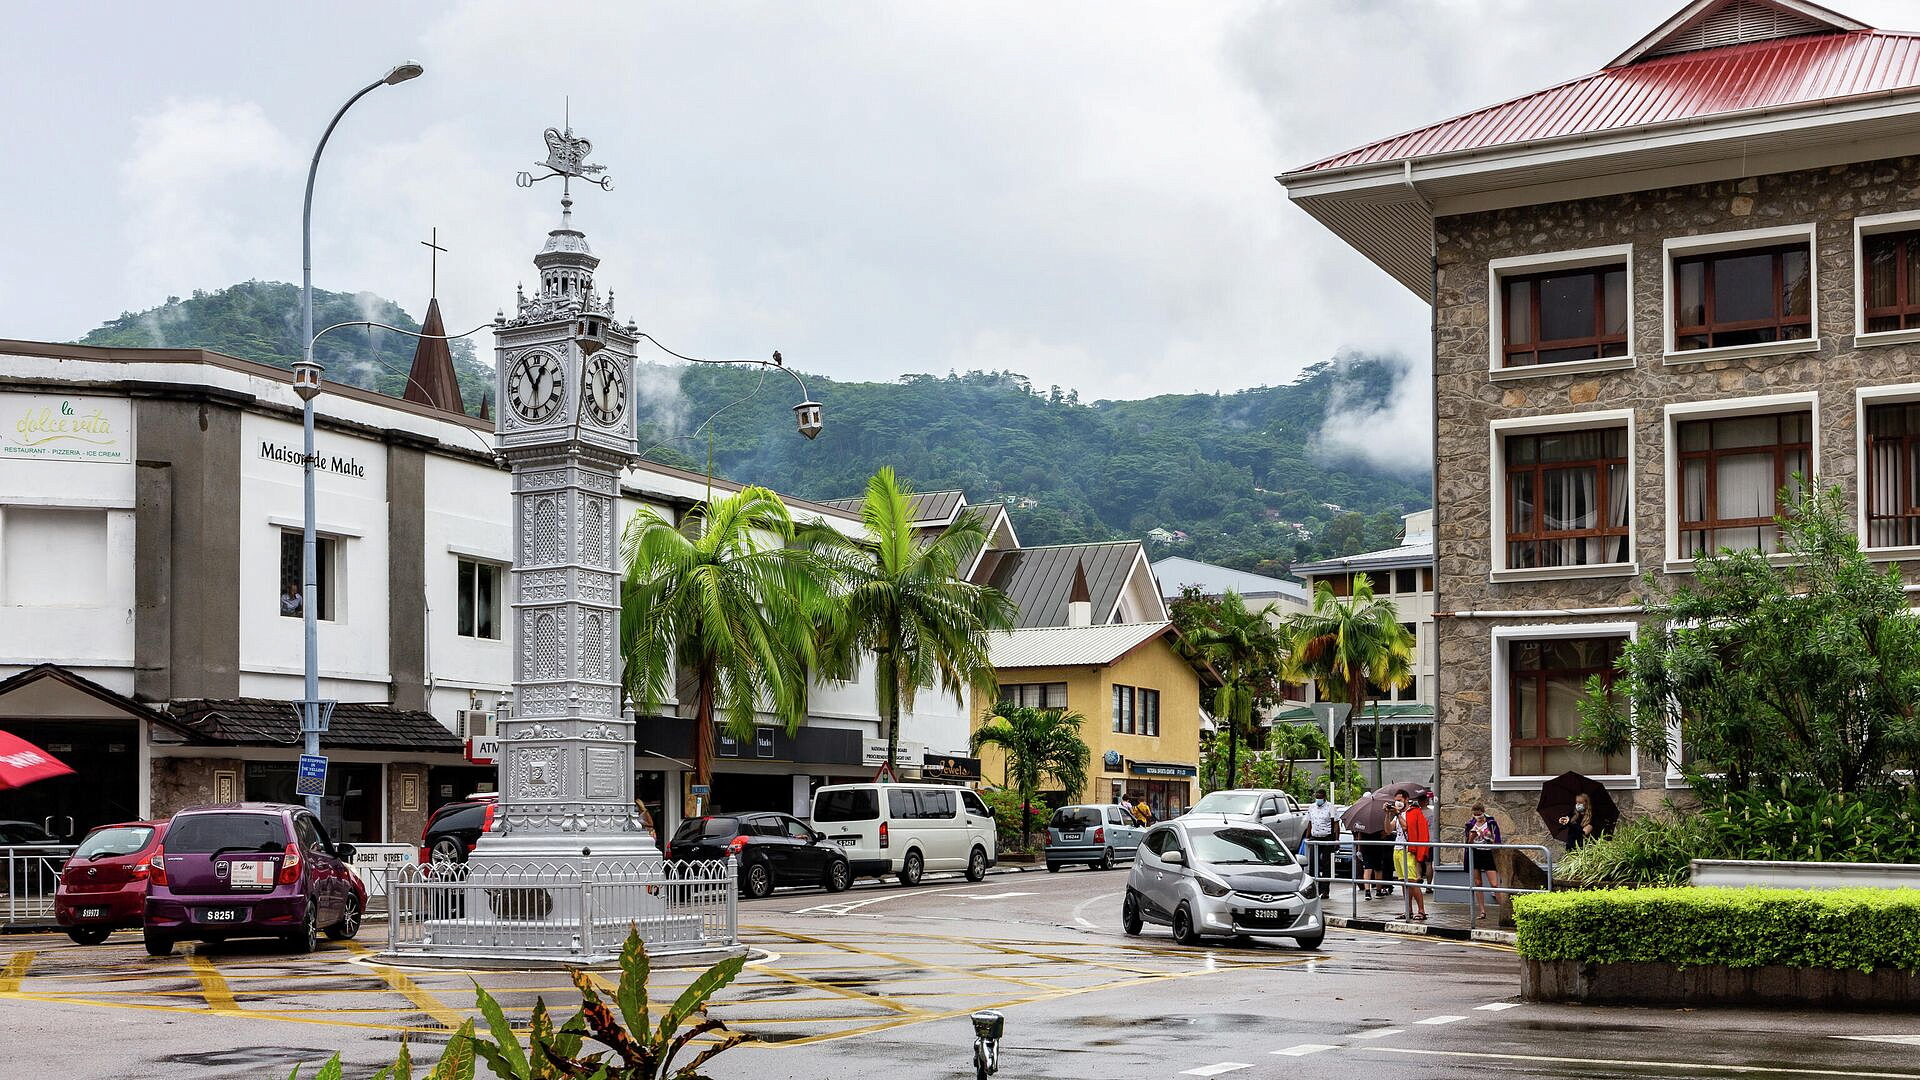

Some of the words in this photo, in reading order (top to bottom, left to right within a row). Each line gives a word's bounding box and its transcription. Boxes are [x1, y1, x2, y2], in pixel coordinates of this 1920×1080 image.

[61, 400, 74, 416] la
[16, 406, 69, 442] dolce
[72, 408, 112, 434] vita
[4, 447, 46, 455] RESTAURANT
[314, 450, 327, 470] de
[331, 456, 365, 478] Mahe
[357, 853, 378, 862] ALBERT
[383, 853, 404, 862] STREET
